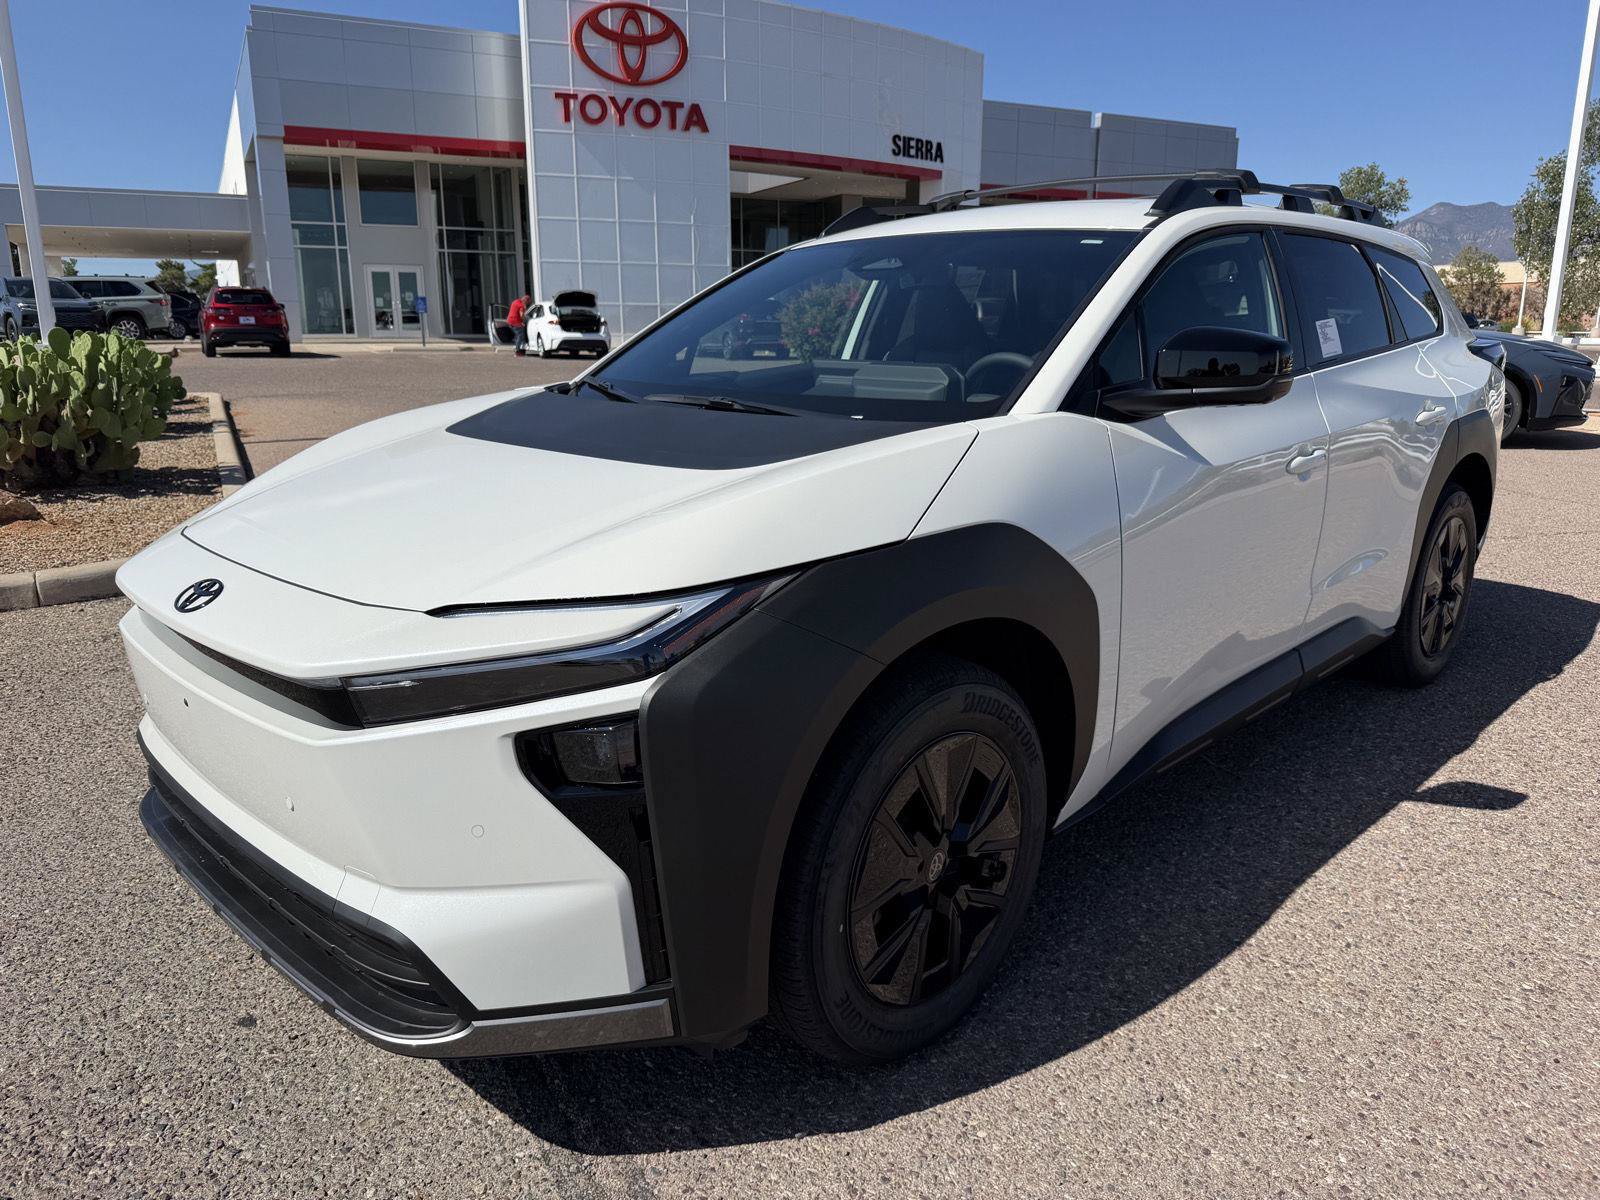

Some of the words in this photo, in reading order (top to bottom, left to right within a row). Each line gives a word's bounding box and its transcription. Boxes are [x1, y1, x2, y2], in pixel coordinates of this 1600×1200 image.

[554, 92, 710, 133] TOYOTA
[892, 134, 944, 163] SIERRA
[960, 691, 1041, 765] BRIDGESTONE
